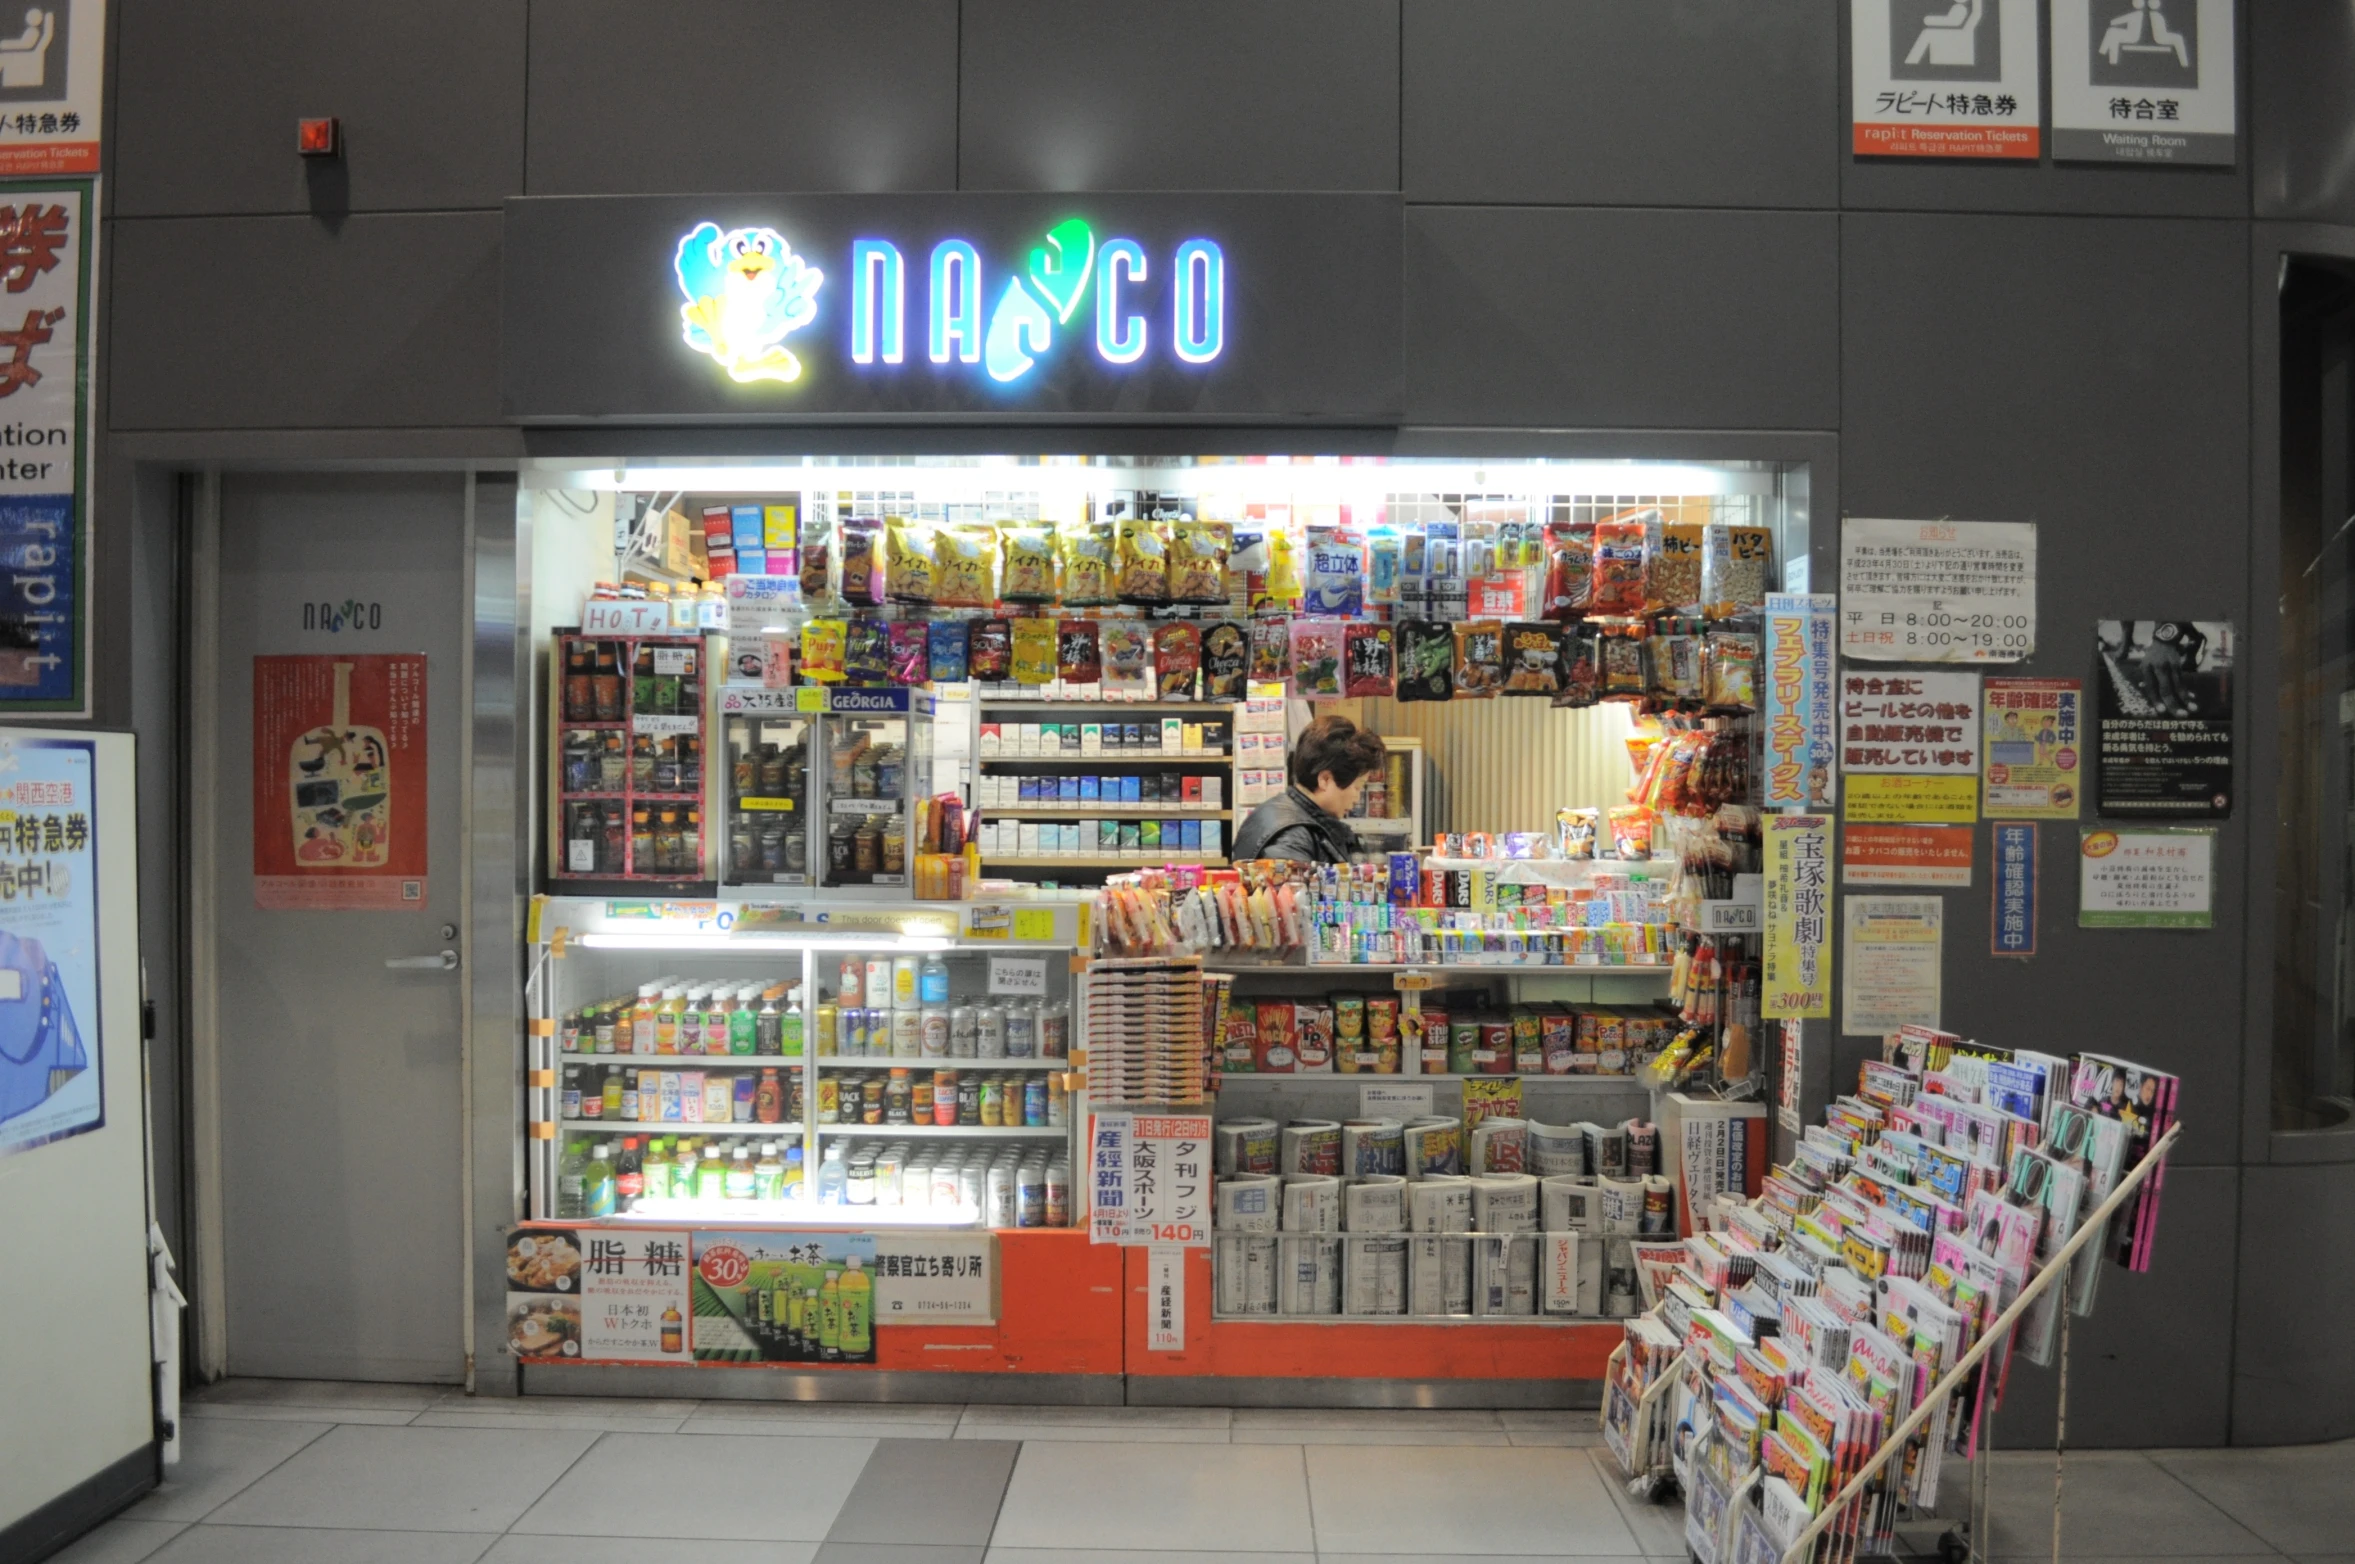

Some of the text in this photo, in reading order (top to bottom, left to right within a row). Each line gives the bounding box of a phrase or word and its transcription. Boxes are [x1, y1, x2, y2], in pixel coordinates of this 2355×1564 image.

[1874, 91, 2018, 116] ラピート特急券
[2109, 97, 2180, 120] 待合室
[1911, 129, 1983, 142] Reservation
[1985, 130, 2029, 143] Tickets
[2103, 132, 2187, 148] Waiting Room
[0, 423, 67, 446] tion
[1732, 532, 1764, 546] バタ
[1919, 525, 1958, 540] お知らせ
[1313, 552, 1359, 575] 超立体
[1932, 600, 1943, 612] 記
[1845, 631, 1896, 645] 土日祝
[1845, 676, 1924, 696] 待合室に
[1770, 617, 1831, 801] フェブラリーステークス 特集号発売中
[1844, 701, 1974, 720] ビールその他を
[1988, 691, 2076, 745] 年齢確認 実施中
[1846, 723, 1964, 743] 自動販売機で
[2102, 719, 2209, 731] 自分のからだは自分で守る。
[1843, 746, 1974, 767] 販売しています
[16, 782, 74, 805] 関西空港
[1879, 778, 1946, 789] お酒コーナー
[1773, 816, 1827, 830] スポニチ
[1432, 870, 1443, 905] DARS
[1457, 870, 1471, 906] DARS
[1484, 871, 1497, 905] DARS
[1793, 833, 1826, 945] 宝塚歌劇
[2003, 827, 2026, 950] 年齢確認実施中
[841, 915, 860, 925] This
[861, 914, 885, 925] door
[919, 916, 942, 927] open
[1767, 922, 1778, 982] サヨナラ特集
[1800, 945, 1818, 987] 特集号
[1687, 1121, 1702, 1214] 日経ヴェリタス
[1133, 1140, 1198, 1220] 大阪スポーツ 夕刊フジ
[1095, 1226, 1130, 1238] 110円
[1151, 1223, 1205, 1241] 140円
[586, 1238, 627, 1276] 脂
[642, 1240, 684, 1277] 糖
[874, 1254, 983, 1278] 警察官立ち寄り所
[1555, 1238, 1570, 1295] ジャパンニュース
[607, 1304, 650, 1317] 日本初
[1160, 1284, 1172, 1330] 産経新聞
[603, 1317, 653, 1331] Wトクホ
